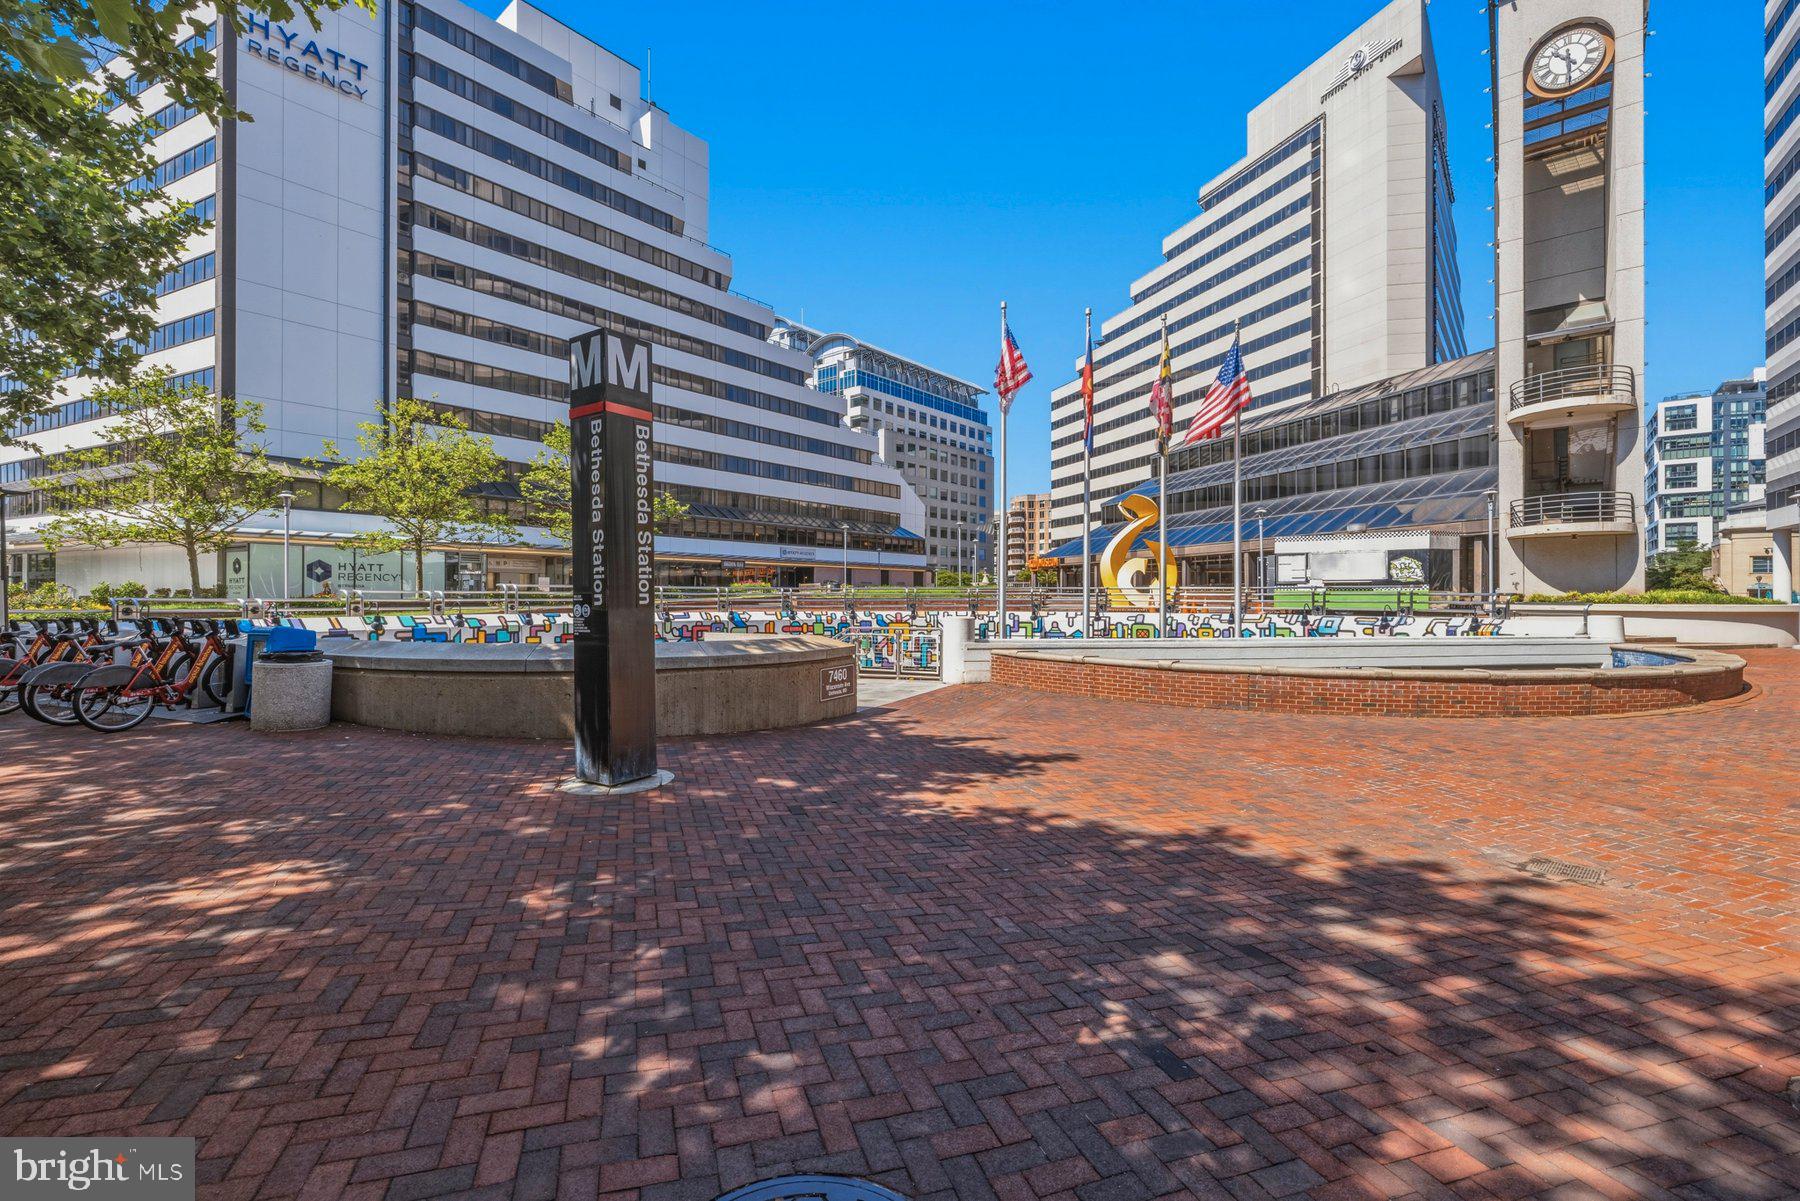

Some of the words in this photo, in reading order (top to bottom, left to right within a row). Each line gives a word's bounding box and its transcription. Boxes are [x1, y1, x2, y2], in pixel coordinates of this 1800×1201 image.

[248, 12, 369, 81] HYATT
[248, 38, 368, 100] REGENCY
[570, 334, 602, 391] M
[607, 335, 648, 394] M
[591, 419, 604, 523] Bethesda
[636, 424, 652, 524] Bethesda
[337, 572, 400, 582] REGENCY
[338, 562, 384, 572] HYATT
[592, 529, 605, 606] Station
[638, 531, 653, 605] Station
[828, 668, 848, 682] 7460
